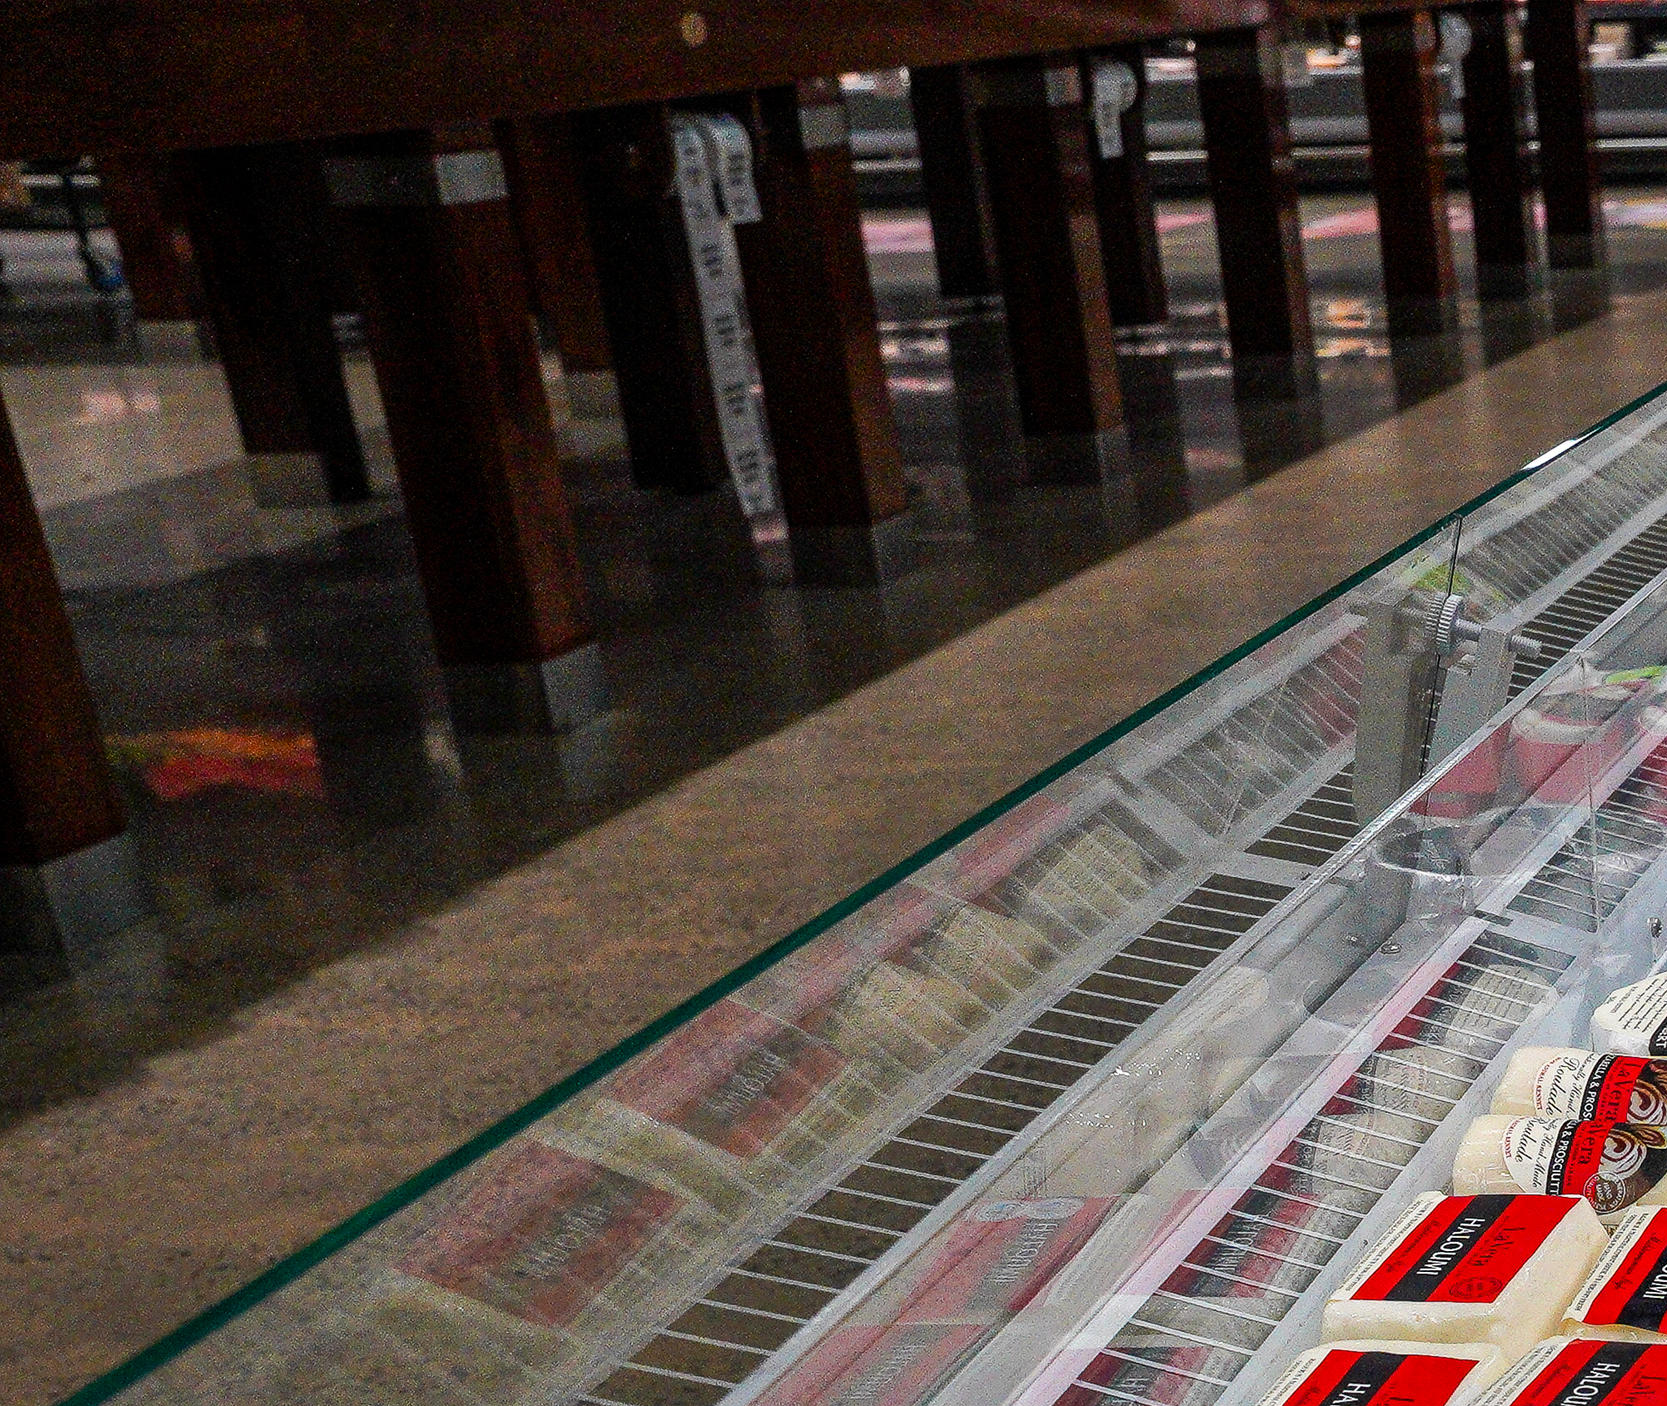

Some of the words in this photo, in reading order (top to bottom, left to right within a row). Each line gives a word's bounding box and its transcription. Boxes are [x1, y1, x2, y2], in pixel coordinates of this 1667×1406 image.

[1545, 1057, 1580, 1117] Roulade
[1546, 1143, 1570, 1196] PROSCIUTT
[1417, 1217, 1485, 1276] HALOUMI
